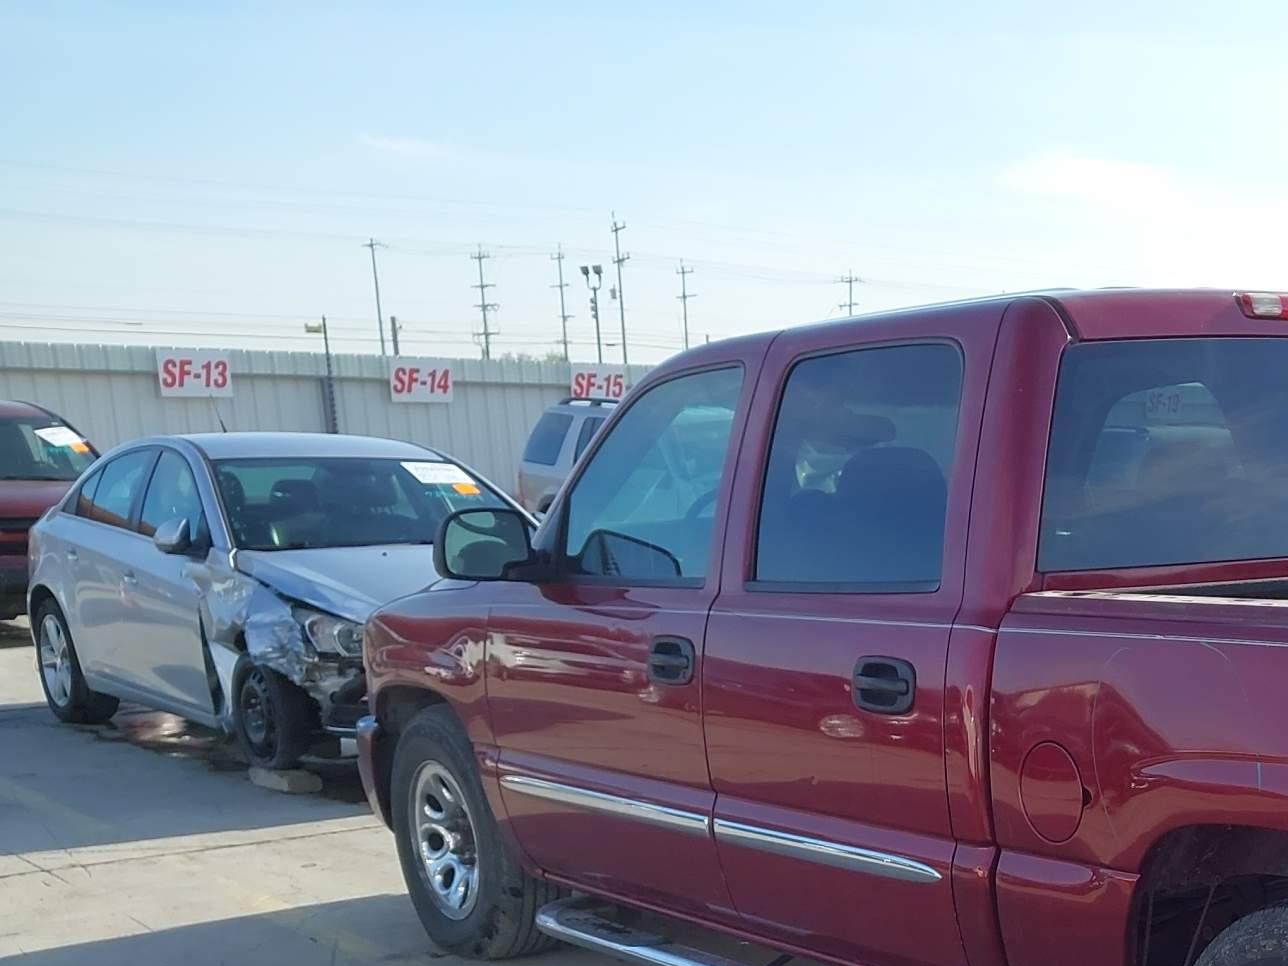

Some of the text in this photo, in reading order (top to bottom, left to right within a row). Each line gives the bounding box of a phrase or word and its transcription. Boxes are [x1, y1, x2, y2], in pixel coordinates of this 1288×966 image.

[161, 358, 228, 389] SF-13
[392, 366, 450, 395] SF-14
[573, 372, 624, 398] SF-15
